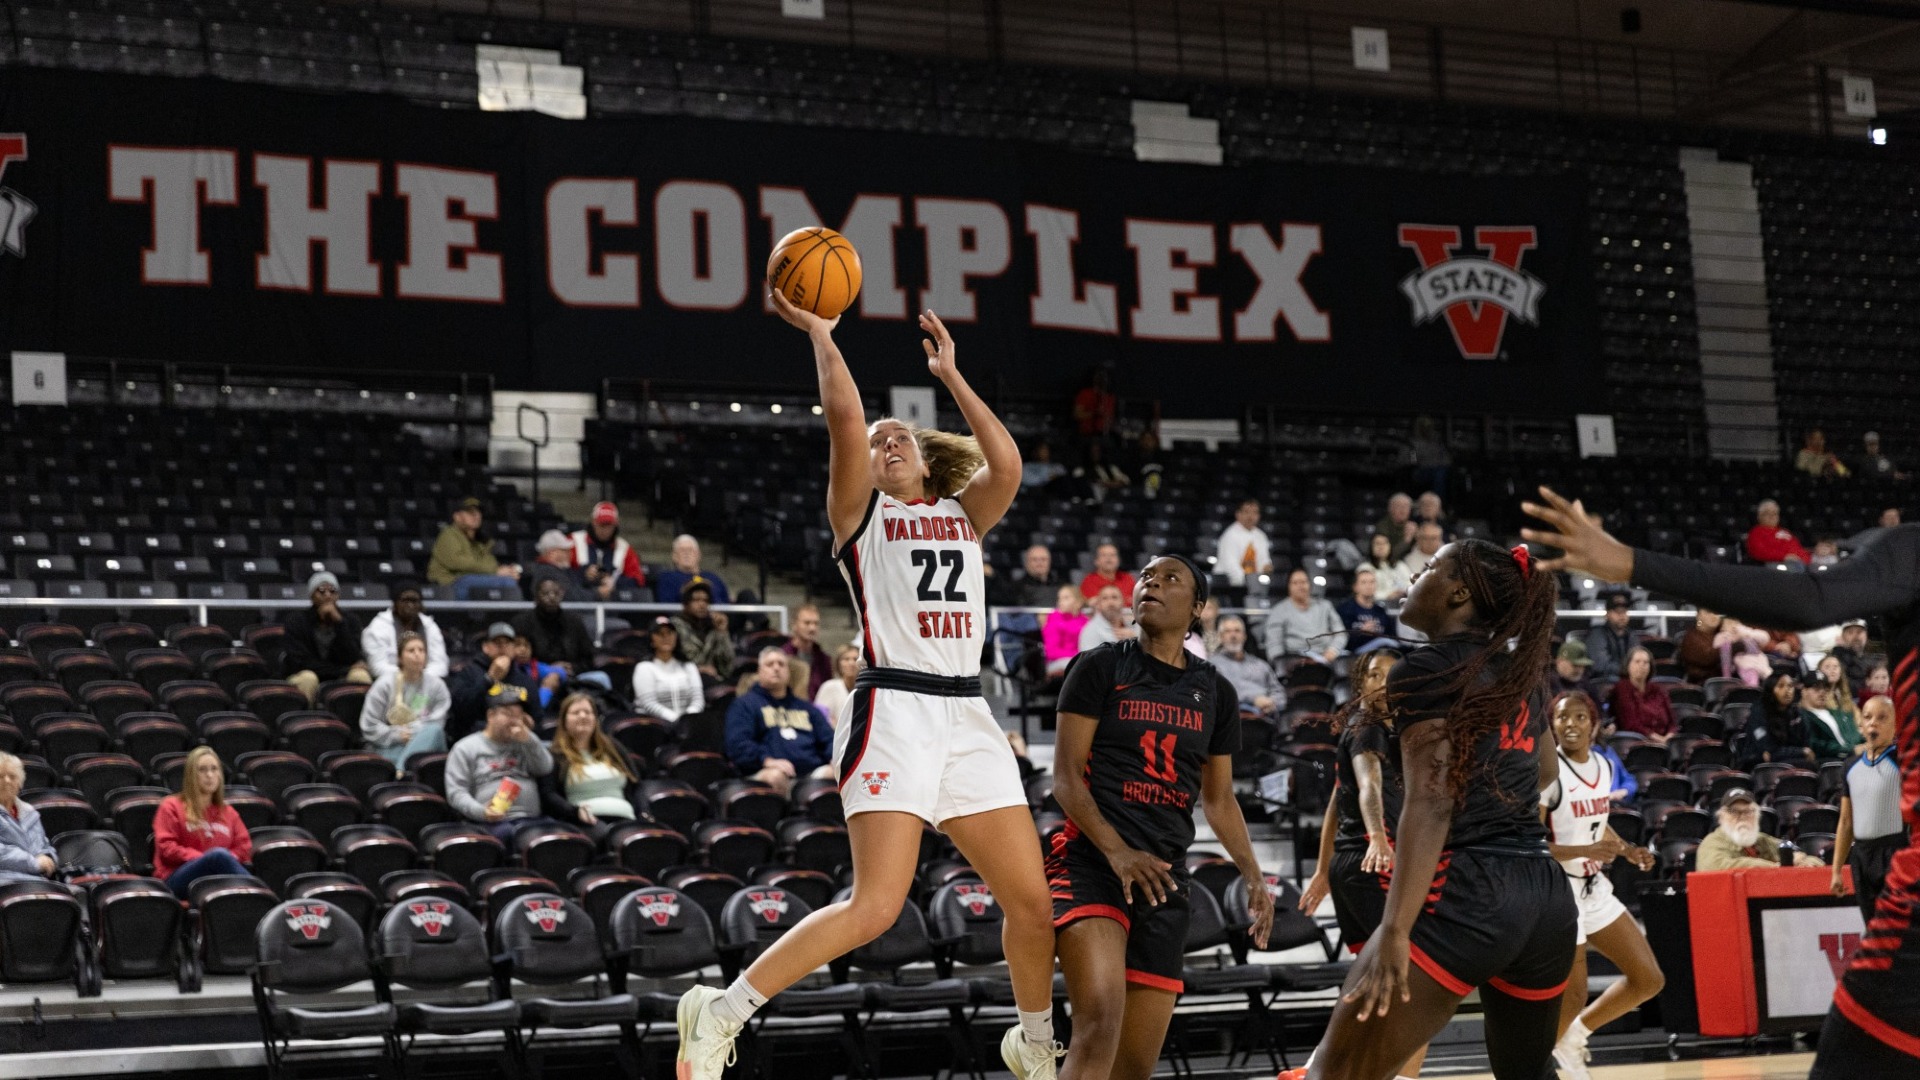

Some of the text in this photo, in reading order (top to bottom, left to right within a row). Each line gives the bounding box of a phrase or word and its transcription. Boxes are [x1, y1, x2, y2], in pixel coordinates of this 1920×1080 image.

[108, 144, 1332, 343] THE COMPLEX
[1398, 223, 1538, 360] V
[1429, 268, 1518, 300] STATE
[883, 516, 978, 544] VALDOSTA
[911, 549, 967, 602] 22
[917, 611, 972, 639] STATE
[1118, 700, 1203, 732] CHRISTIAN
[1140, 730, 1178, 784] 11
[1590, 821, 1601, 843] 7
